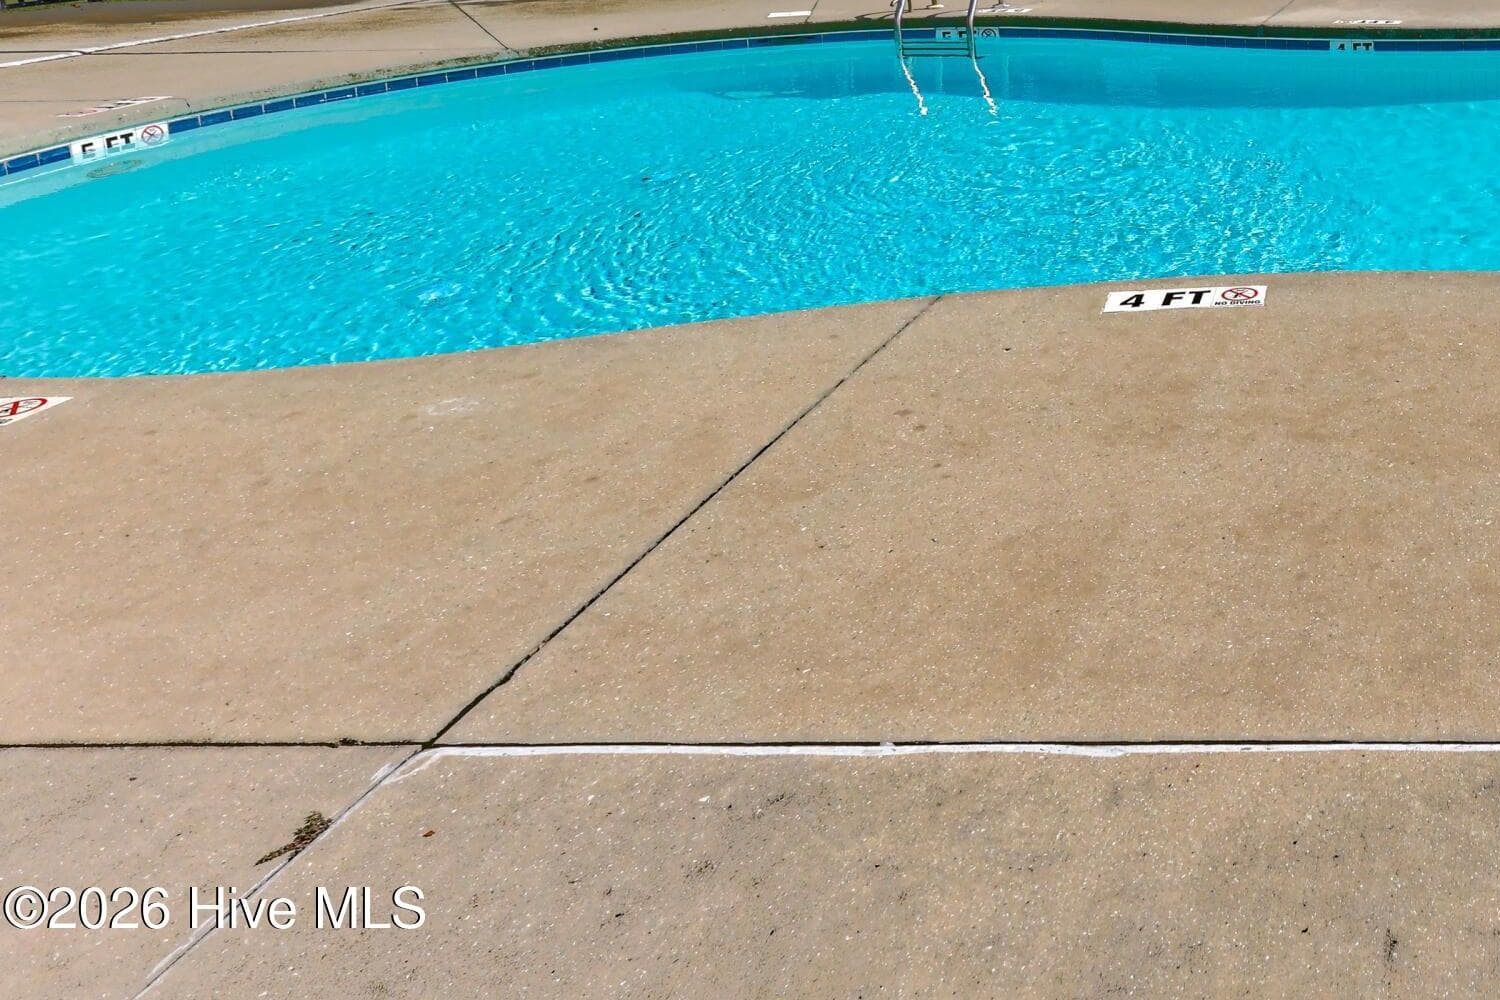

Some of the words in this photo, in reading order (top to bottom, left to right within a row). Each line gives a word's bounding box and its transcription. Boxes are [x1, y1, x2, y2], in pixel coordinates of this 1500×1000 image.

[1352, 42, 1373, 51] FT
[1119, 293, 1145, 308] 4
[1161, 290, 1212, 307] FT
